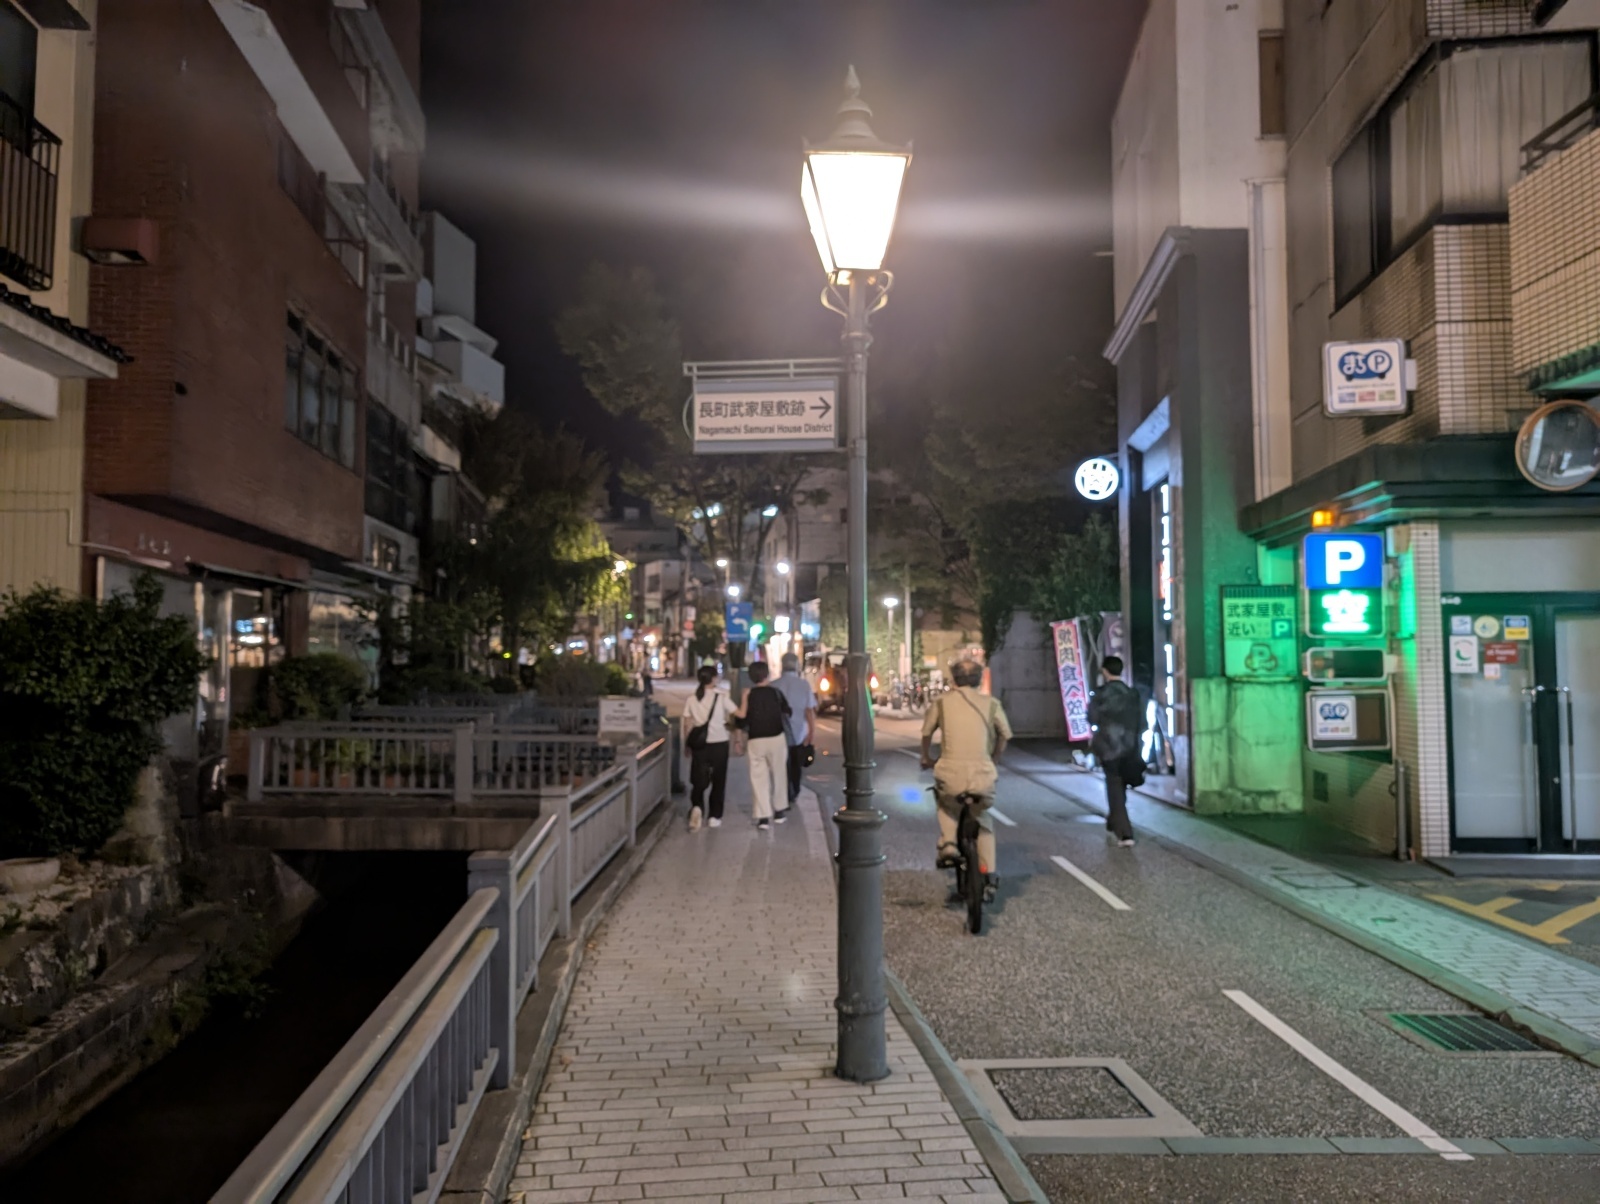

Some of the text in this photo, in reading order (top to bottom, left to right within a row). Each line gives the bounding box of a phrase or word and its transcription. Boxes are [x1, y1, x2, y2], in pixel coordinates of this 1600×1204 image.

[1374, 355, 1386, 371] P
[699, 399, 806, 419] 長町武家屋敷跡
[699, 422, 832, 437] Nagamachi Samurai House District
[1325, 540, 1366, 585] P
[1228, 621, 1290, 637] 近い P
